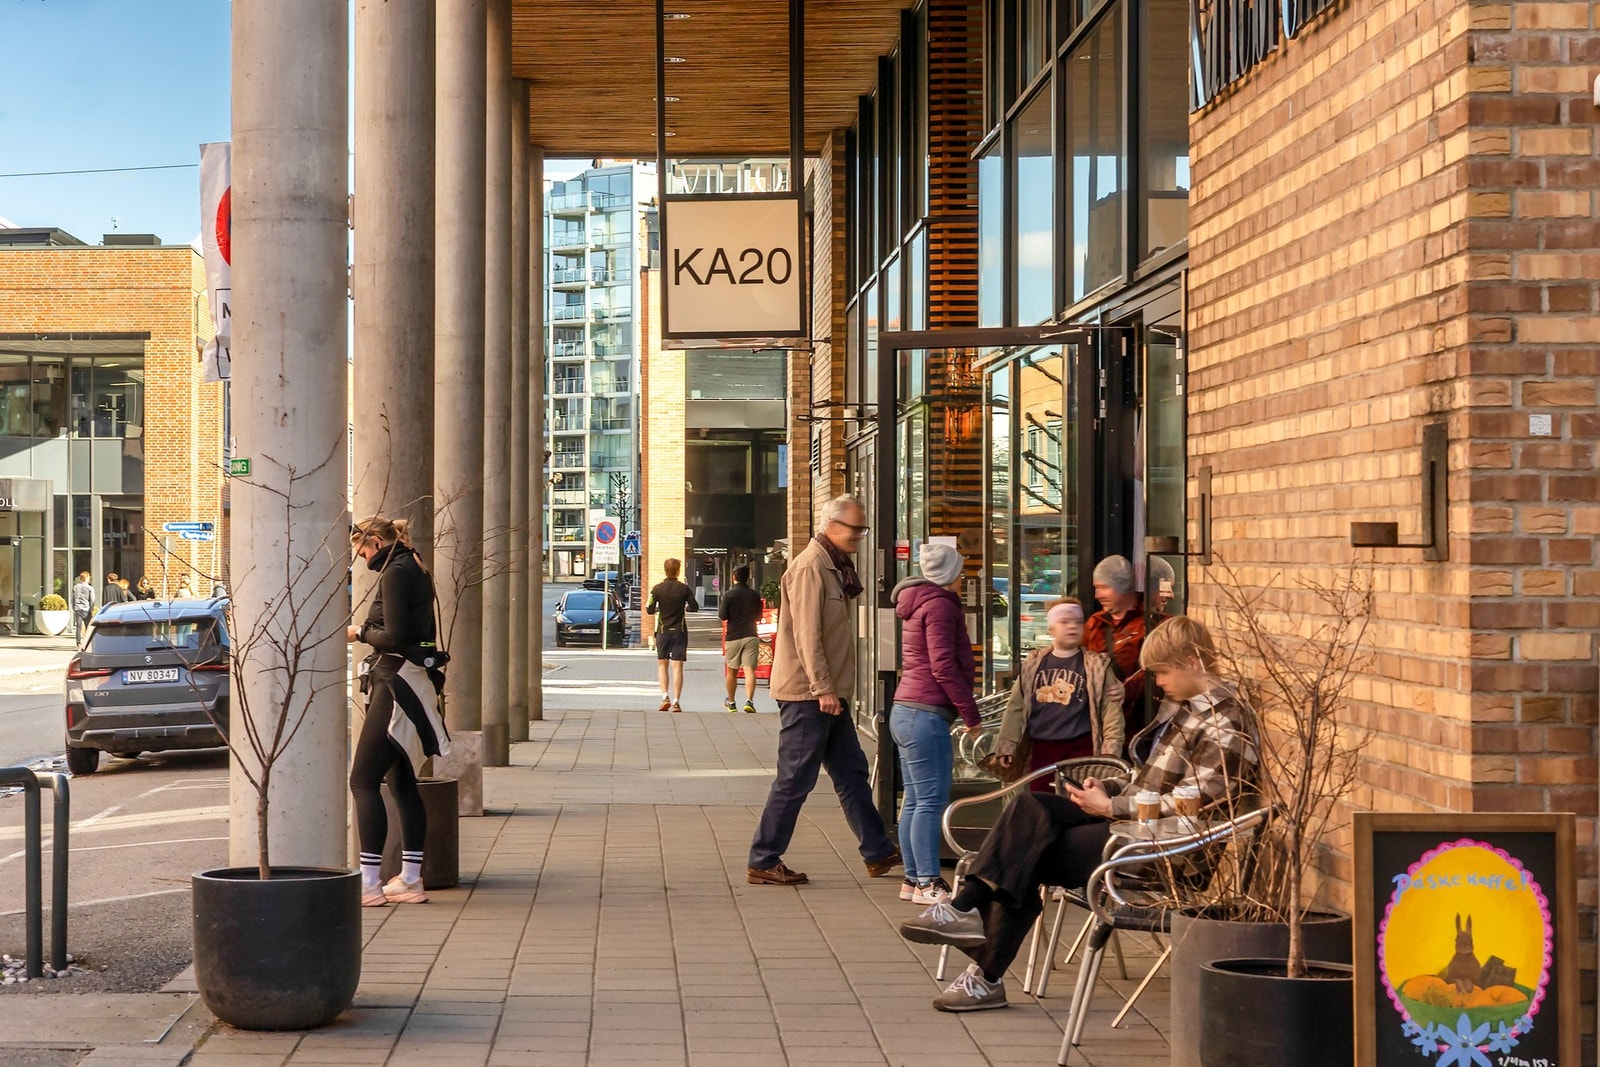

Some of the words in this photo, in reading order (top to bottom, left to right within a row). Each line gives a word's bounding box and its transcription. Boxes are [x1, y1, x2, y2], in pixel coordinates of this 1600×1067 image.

[673, 247, 793, 286] KA20
[129, 670, 143, 681] NV
[147, 669, 177, 680] 80347
